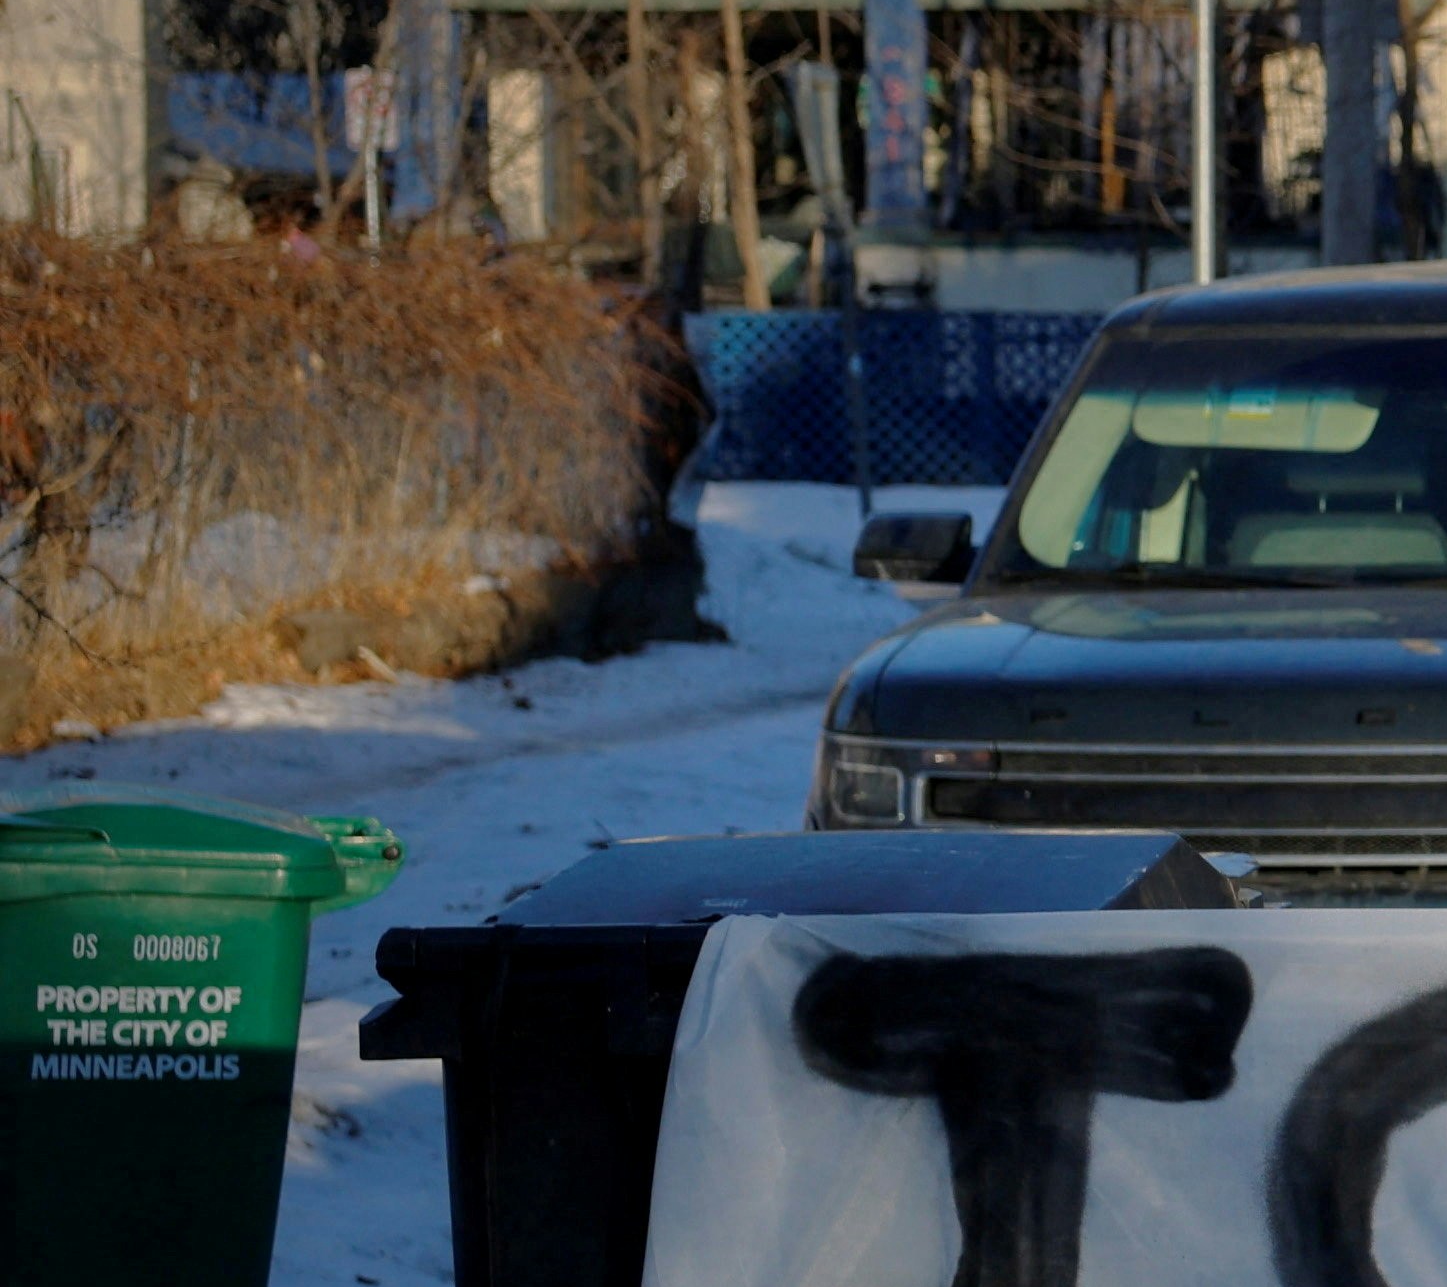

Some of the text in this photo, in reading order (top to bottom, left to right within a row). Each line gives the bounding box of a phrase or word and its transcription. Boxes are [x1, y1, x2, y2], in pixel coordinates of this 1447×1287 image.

[133, 934, 222, 962] 0008067
[36, 984, 243, 1014] PROPERTY OF
[47, 1018, 228, 1047] THE CITY OF
[31, 1052, 241, 1081] MINNEAPOLIS
